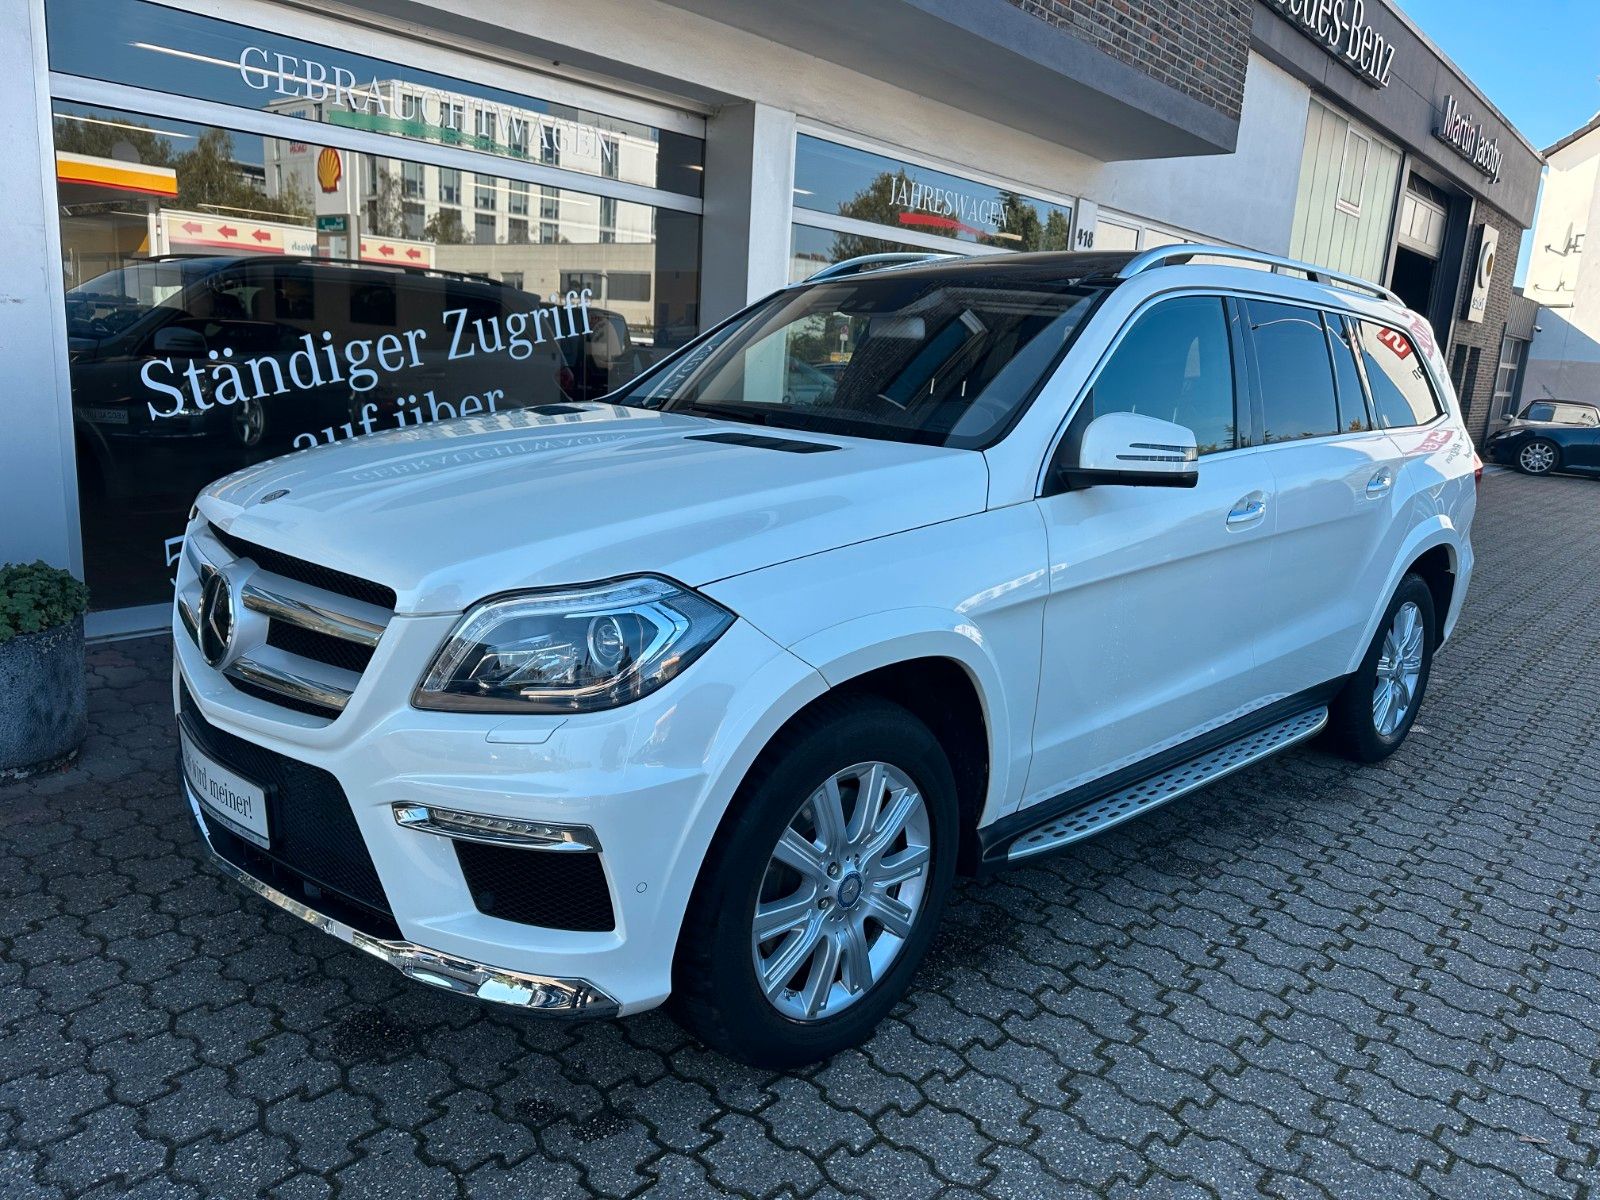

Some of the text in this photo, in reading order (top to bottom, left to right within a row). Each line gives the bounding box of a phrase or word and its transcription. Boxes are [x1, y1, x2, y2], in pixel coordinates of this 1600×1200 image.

[1279, 0, 1395, 87] es-Benz
[239, 46, 614, 163] GEBRAUCHTWAGEN
[1443, 95, 1504, 184] Martin Jacoby
[889, 177, 1010, 229] JAHRESWAGEN
[1077, 228, 1094, 248] 418
[140, 288, 594, 421] Ständiger Zugriff
[209, 778, 253, 819] meiner!
